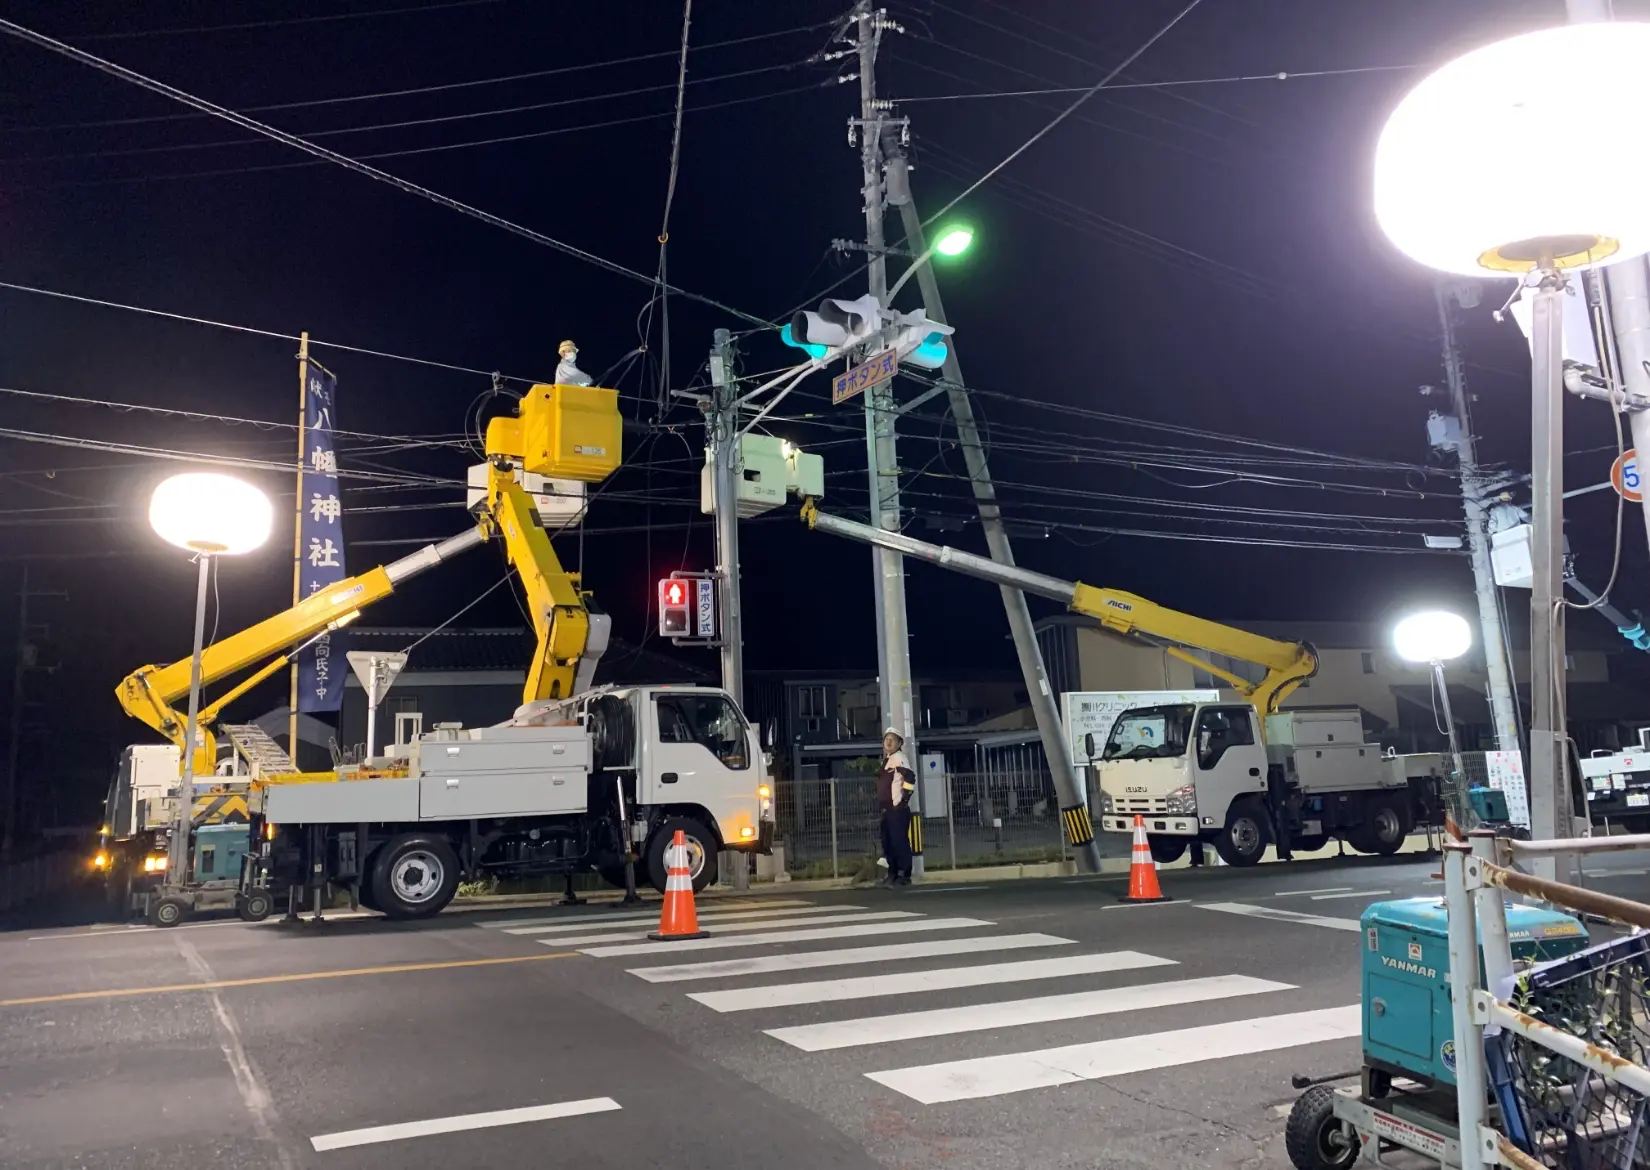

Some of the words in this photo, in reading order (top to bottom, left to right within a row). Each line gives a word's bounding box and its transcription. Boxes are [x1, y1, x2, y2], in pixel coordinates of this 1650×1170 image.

[836, 354, 894, 398] 押ボタン式
[308, 407, 342, 567] 八幡神社
[1623, 464, 1640, 488] 5
[700, 583, 712, 633] 押ボタン式
[1107, 599, 1132, 612] AICHI
[1381, 955, 1437, 979] YANMAR
